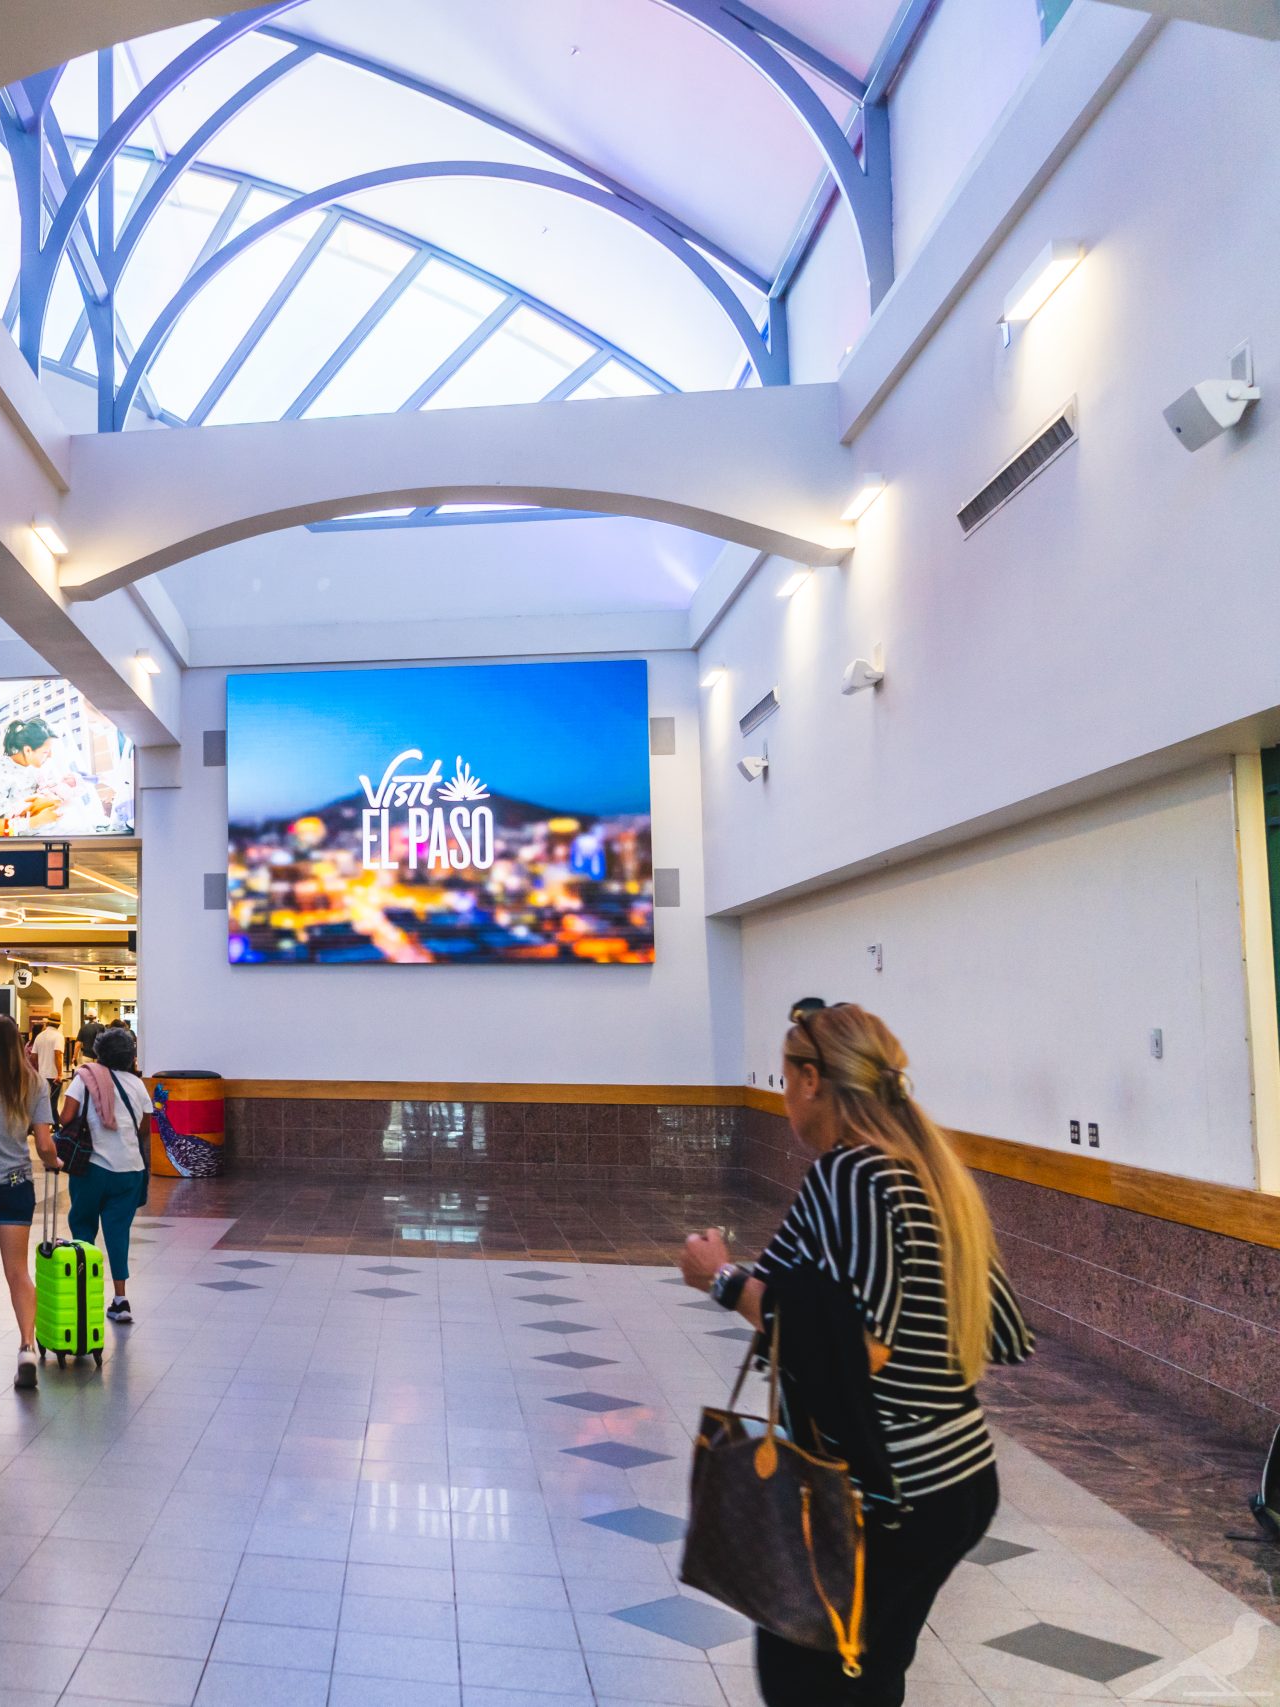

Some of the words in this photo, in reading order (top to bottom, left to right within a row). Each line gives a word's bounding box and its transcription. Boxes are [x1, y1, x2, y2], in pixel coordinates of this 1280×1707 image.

[358, 748, 443, 809] Visit
[362, 807, 399, 870] EL
[408, 806, 495, 870] PASO
